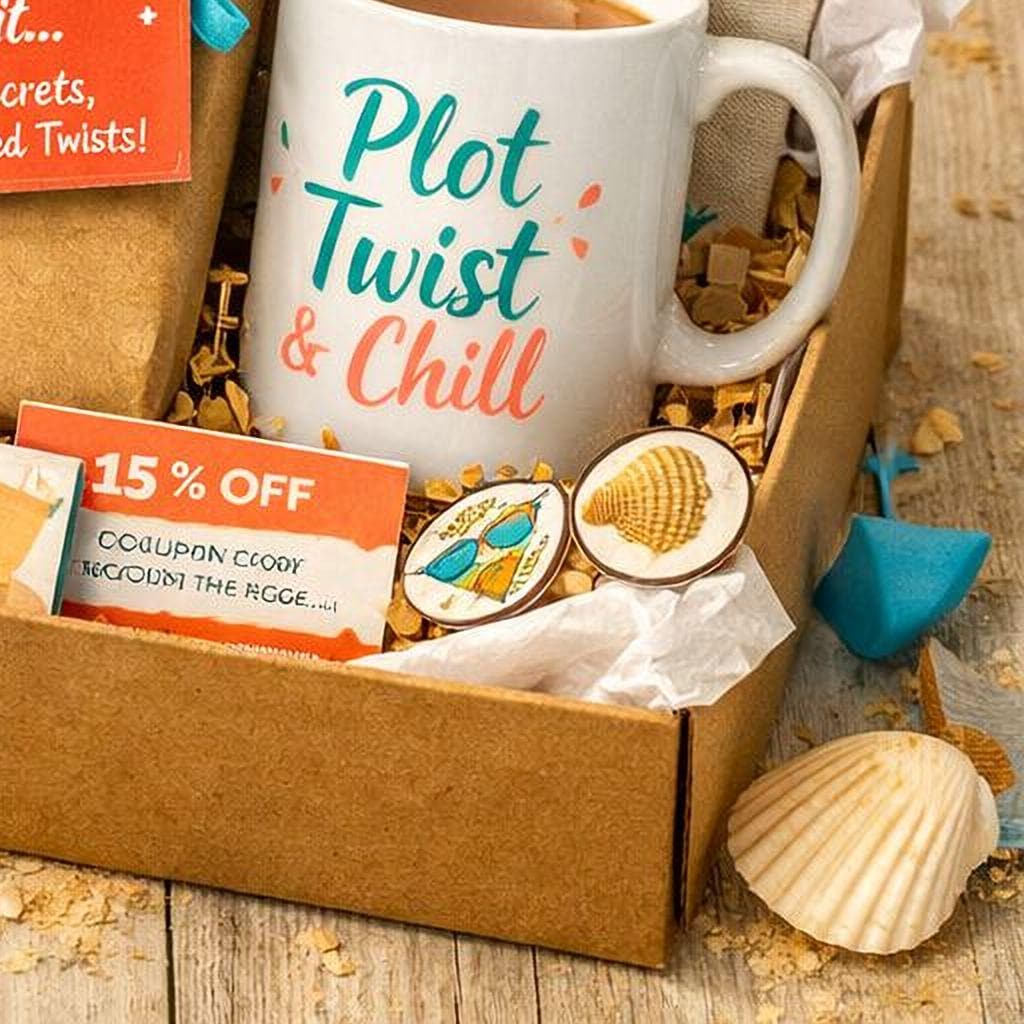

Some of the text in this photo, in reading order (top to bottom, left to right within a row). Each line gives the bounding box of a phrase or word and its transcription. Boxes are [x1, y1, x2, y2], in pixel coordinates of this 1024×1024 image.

[36, 118, 147, 155] Twists!
[343, 78, 551, 208] Plot
[304, 182, 550, 320] Twist
[281, 305, 547, 419] & Chill
[220, 468, 316, 511] OFF
[193, 575, 237, 597] THE
